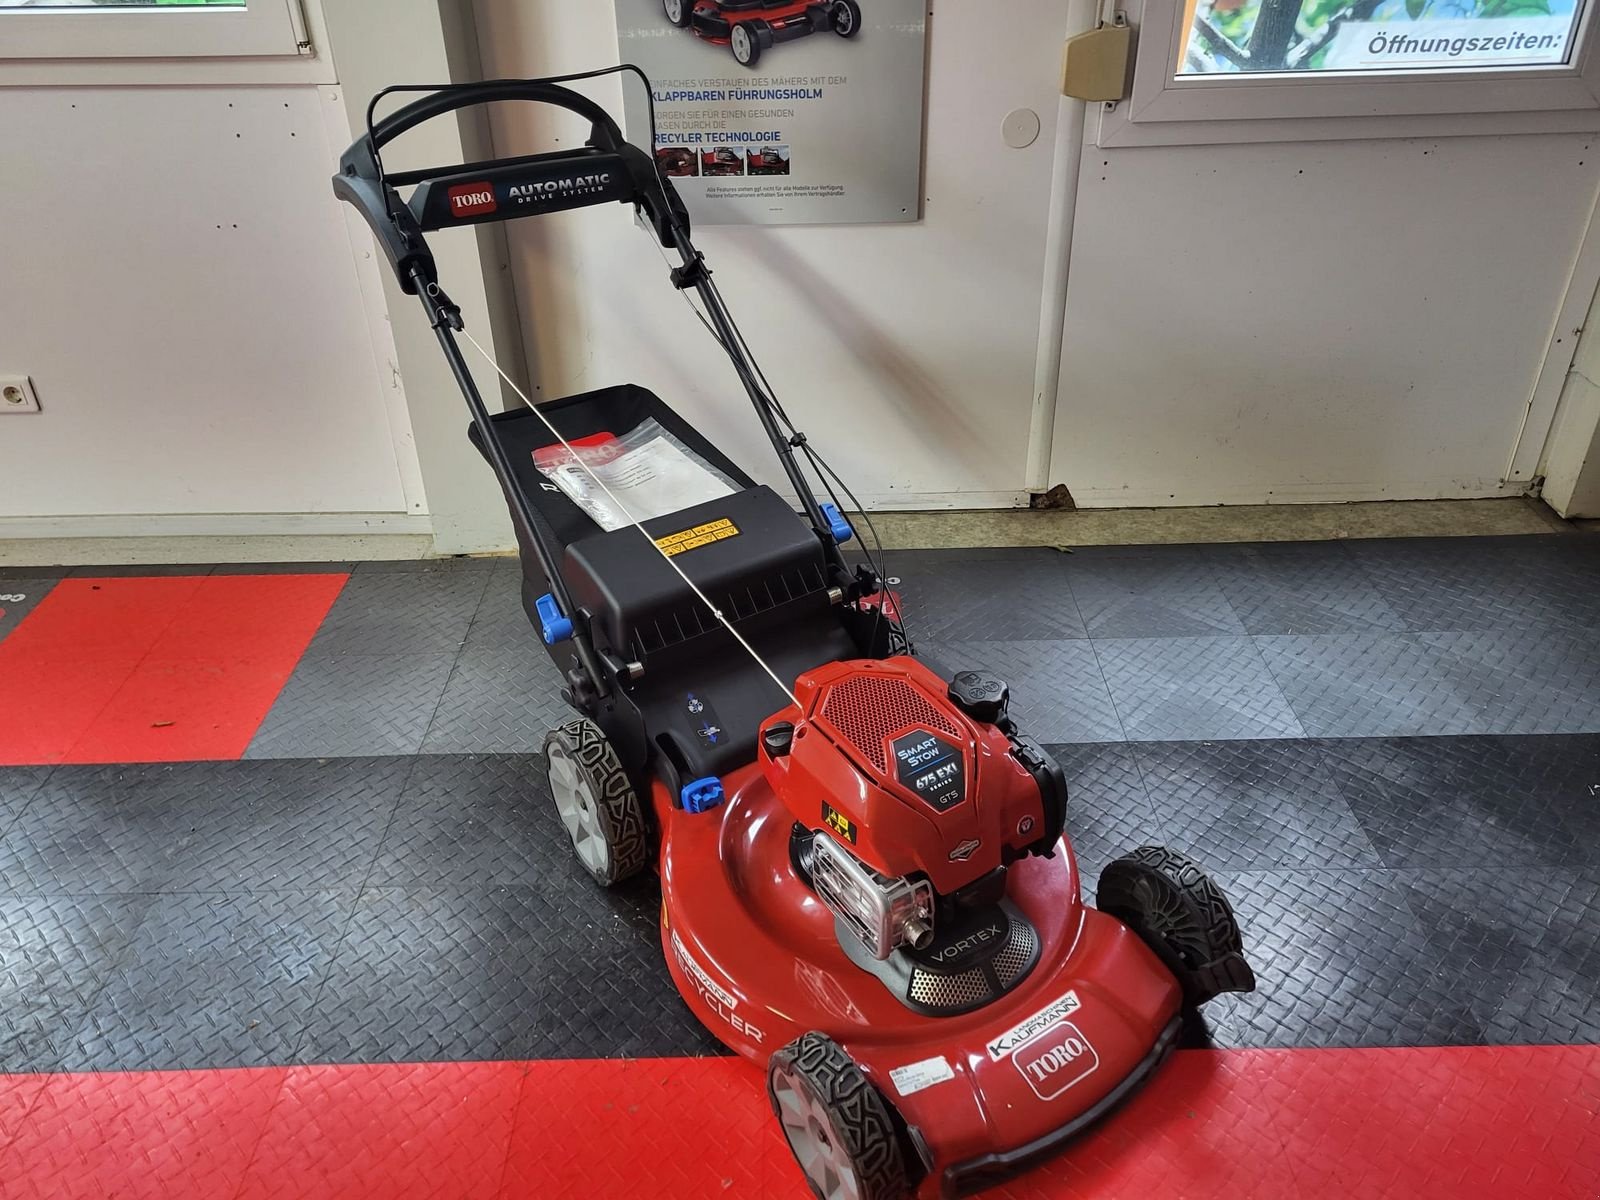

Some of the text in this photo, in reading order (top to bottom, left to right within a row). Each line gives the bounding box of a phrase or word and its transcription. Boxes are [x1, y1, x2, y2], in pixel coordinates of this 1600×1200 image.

[1368, 31, 1562, 56] Öffnungszeiten:
[697, 78, 749, 88] VERSTAUEN
[751, 77, 769, 87] DES
[810, 76, 826, 85] MIT
[828, 76, 847, 85] DEM
[651, 87, 823, 102] KLAPPBAREN FÜHRUNGSHOLM
[655, 108, 794, 120] ORGEN SIE FÜR EINEN GESUNDEN
[681, 121, 711, 130] DURCH
[712, 120, 726, 129] DIE
[705, 131, 781, 143] TECHNOLOGIE
[509, 173, 610, 198] AUTOMATIC
[452, 191, 492, 208] TORO
[518, 186, 604, 204] DRIVE SYSTEM
[897, 737, 937, 760] SMART
[907, 747, 940, 767] STOW
[916, 771, 937, 789] 675
[939, 790, 959, 804] GTS
[930, 924, 1002, 962] VORTEX
[1013, 995, 1073, 1035] LANDMASCHINEN
[989, 998, 1078, 1057] KAUFMANN
[1026, 1037, 1083, 1082] TORO
